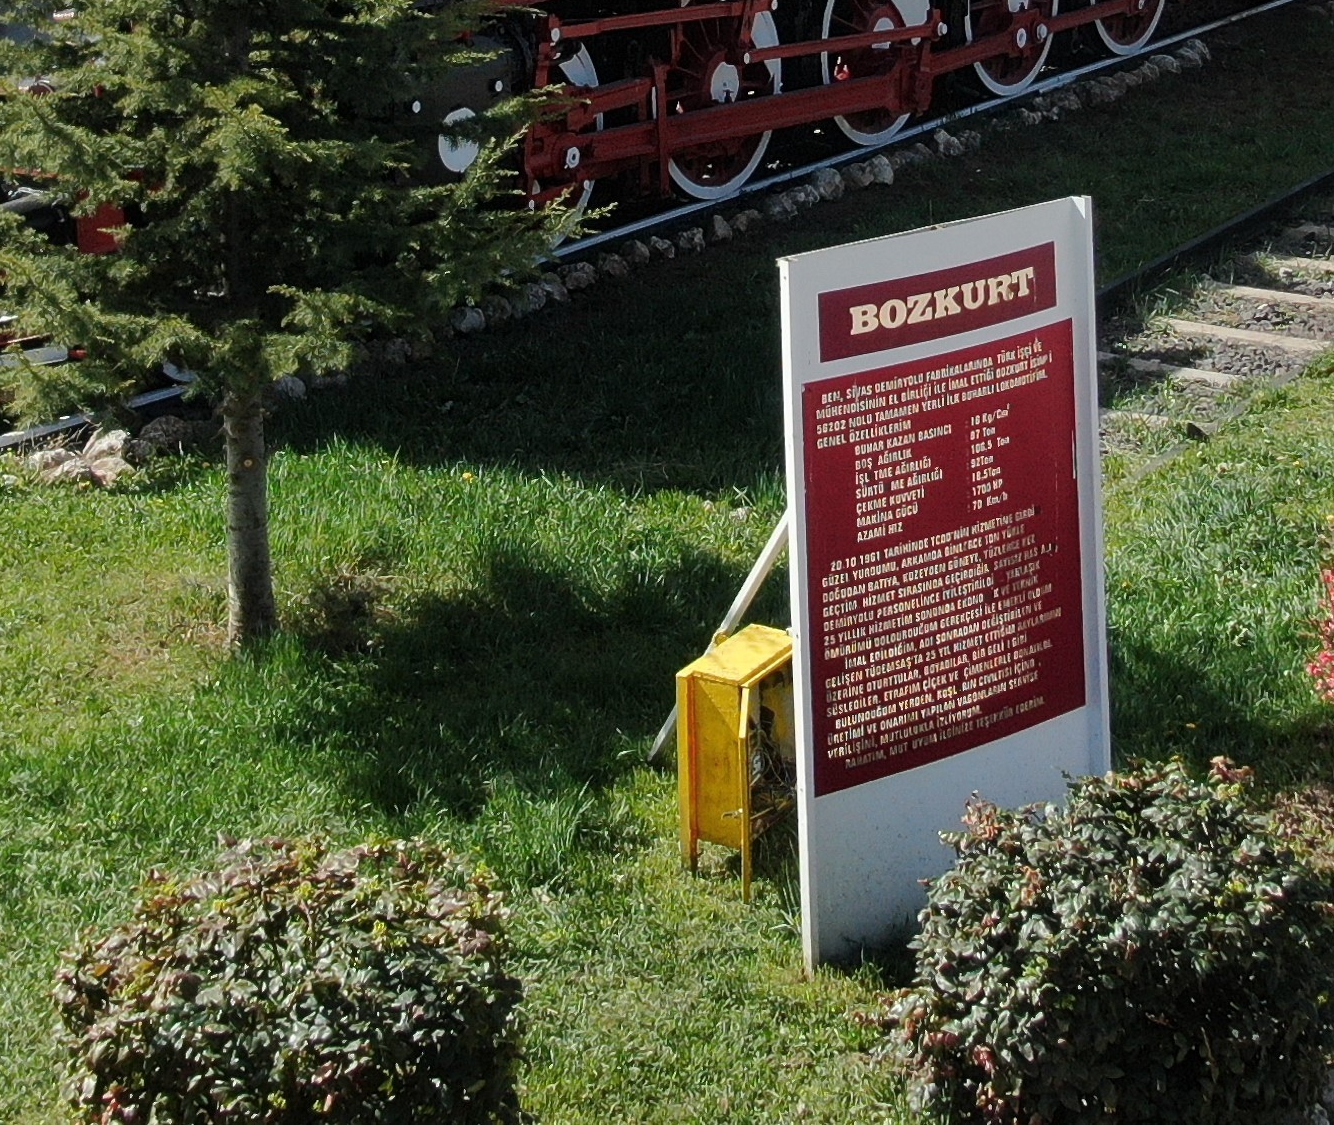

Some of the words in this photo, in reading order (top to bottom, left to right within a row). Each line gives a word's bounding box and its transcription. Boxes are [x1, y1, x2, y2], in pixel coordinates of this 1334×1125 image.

[849, 266, 1035, 336] BOZKURT
[888, 393, 898, 405] EL
[933, 382, 946, 394] İLE
[948, 376, 968, 391] İMAL
[816, 419, 846, 434] 56202
[848, 413, 872, 428] NOLU
[875, 403, 919, 422] TAMAMEN
[921, 394, 944, 411] YERLİ
[946, 393, 959, 405] İLK
[816, 433, 846, 449] GENEL
[854, 439, 883, 456] BUHAR
[886, 432, 915, 449] KAZAN
[918, 423, 951, 441] BASINCI
[970, 414, 979, 426] 16
[855, 456, 872, 470] BOŞ
[877, 447, 912, 465] AĞIRLIK
[856, 496, 886, 515] ÇEKME
[889, 485, 924, 506] KUVVETİ
[856, 509, 893, 528] MAKİNA
[895, 501, 918, 518] GÜCÜ
[972, 482, 991, 496] 1700
[857, 523, 885, 542] AZAMİ
[888, 521, 903, 535] HIZ
[901, 548, 942, 569] ARKAMDA
[984, 531, 999, 545] TON
[822, 583, 865, 603] DOĞUDAN
[862, 589, 895, 608] HİZMET
[898, 576, 943, 598] SIRASINDA
[984, 602, 996, 614] İLE
[824, 633, 835, 646] 25
[838, 626, 866, 642] YILLIK
[844, 654, 866, 669] İMAL
[919, 635, 932, 649] ADI
[935, 621, 979, 644] SONRADAN
[825, 669, 862, 689] GELİŞEN
[925, 649, 935, 661] 25
[938, 645, 950, 657] YIL
[883, 681, 920, 701] ETRAFIM
[922, 673, 946, 692] ÇİÇEK
[948, 670, 958, 682] VE
[866, 722, 877, 735] VE
